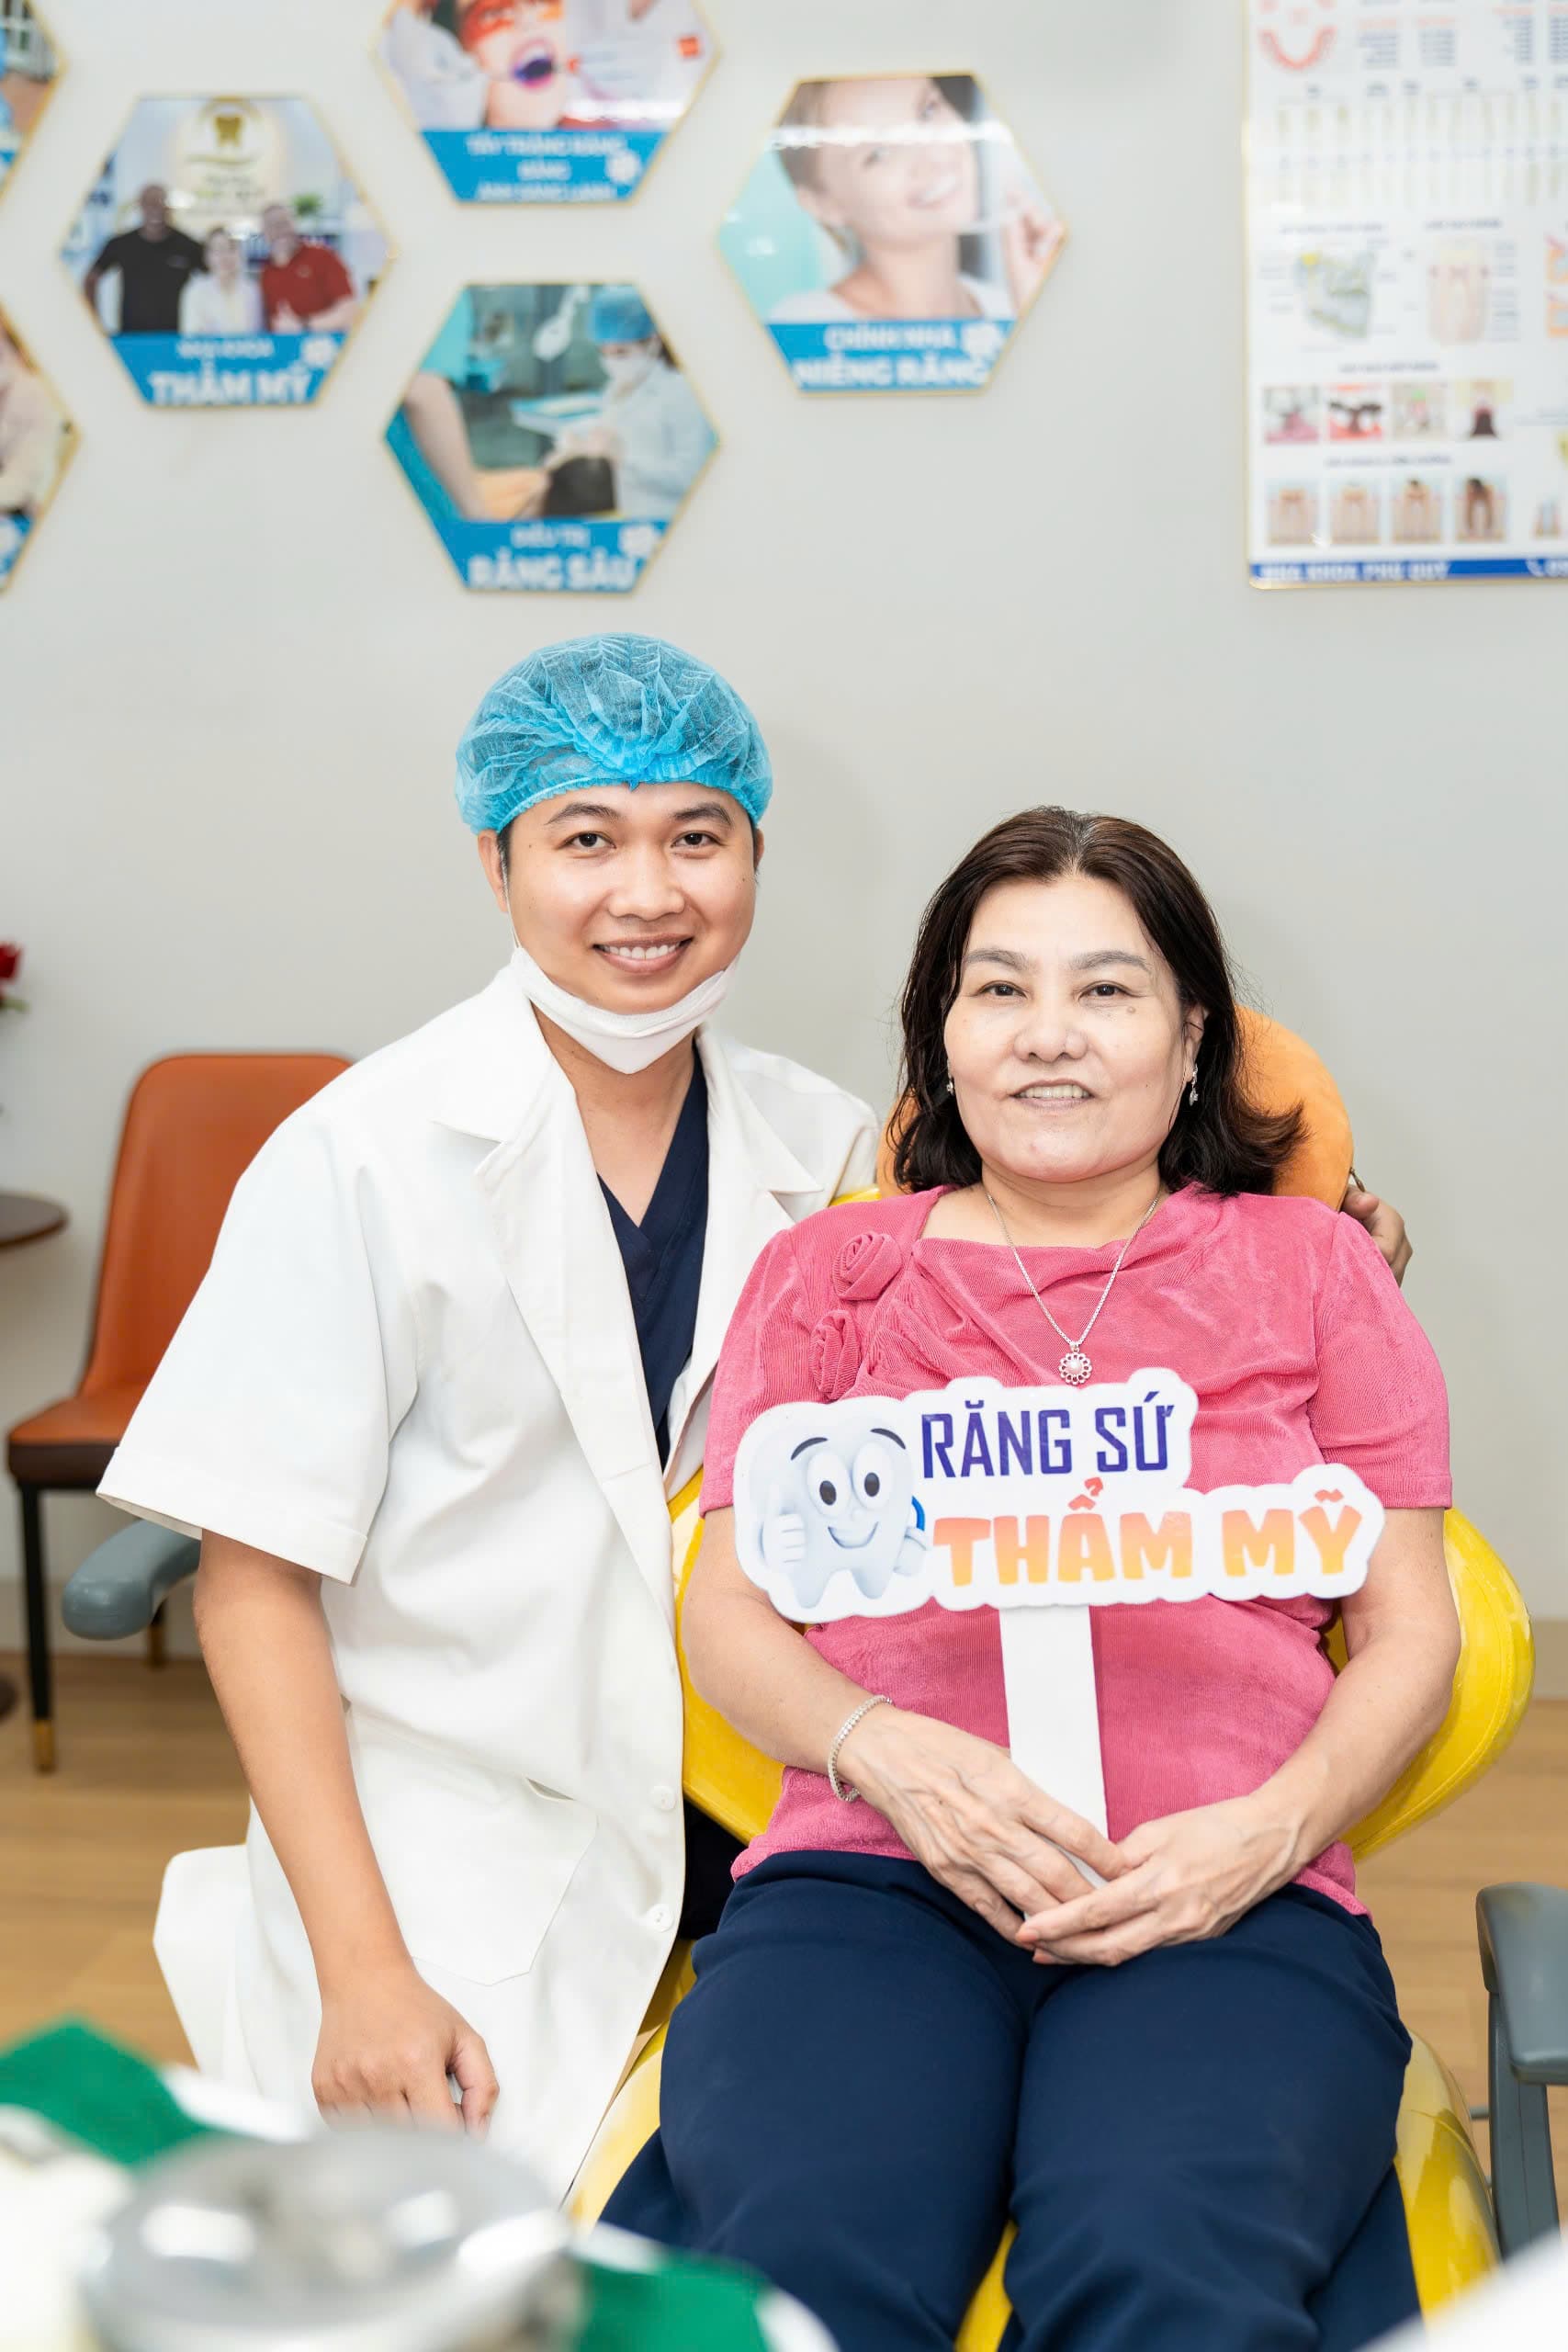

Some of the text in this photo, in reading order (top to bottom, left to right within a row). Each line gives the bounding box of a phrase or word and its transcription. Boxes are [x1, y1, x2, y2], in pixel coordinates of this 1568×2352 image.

[921, 1390, 1174, 1479] RĂNG SỨ
[932, 1476, 1362, 1588] THẨM MỸ
